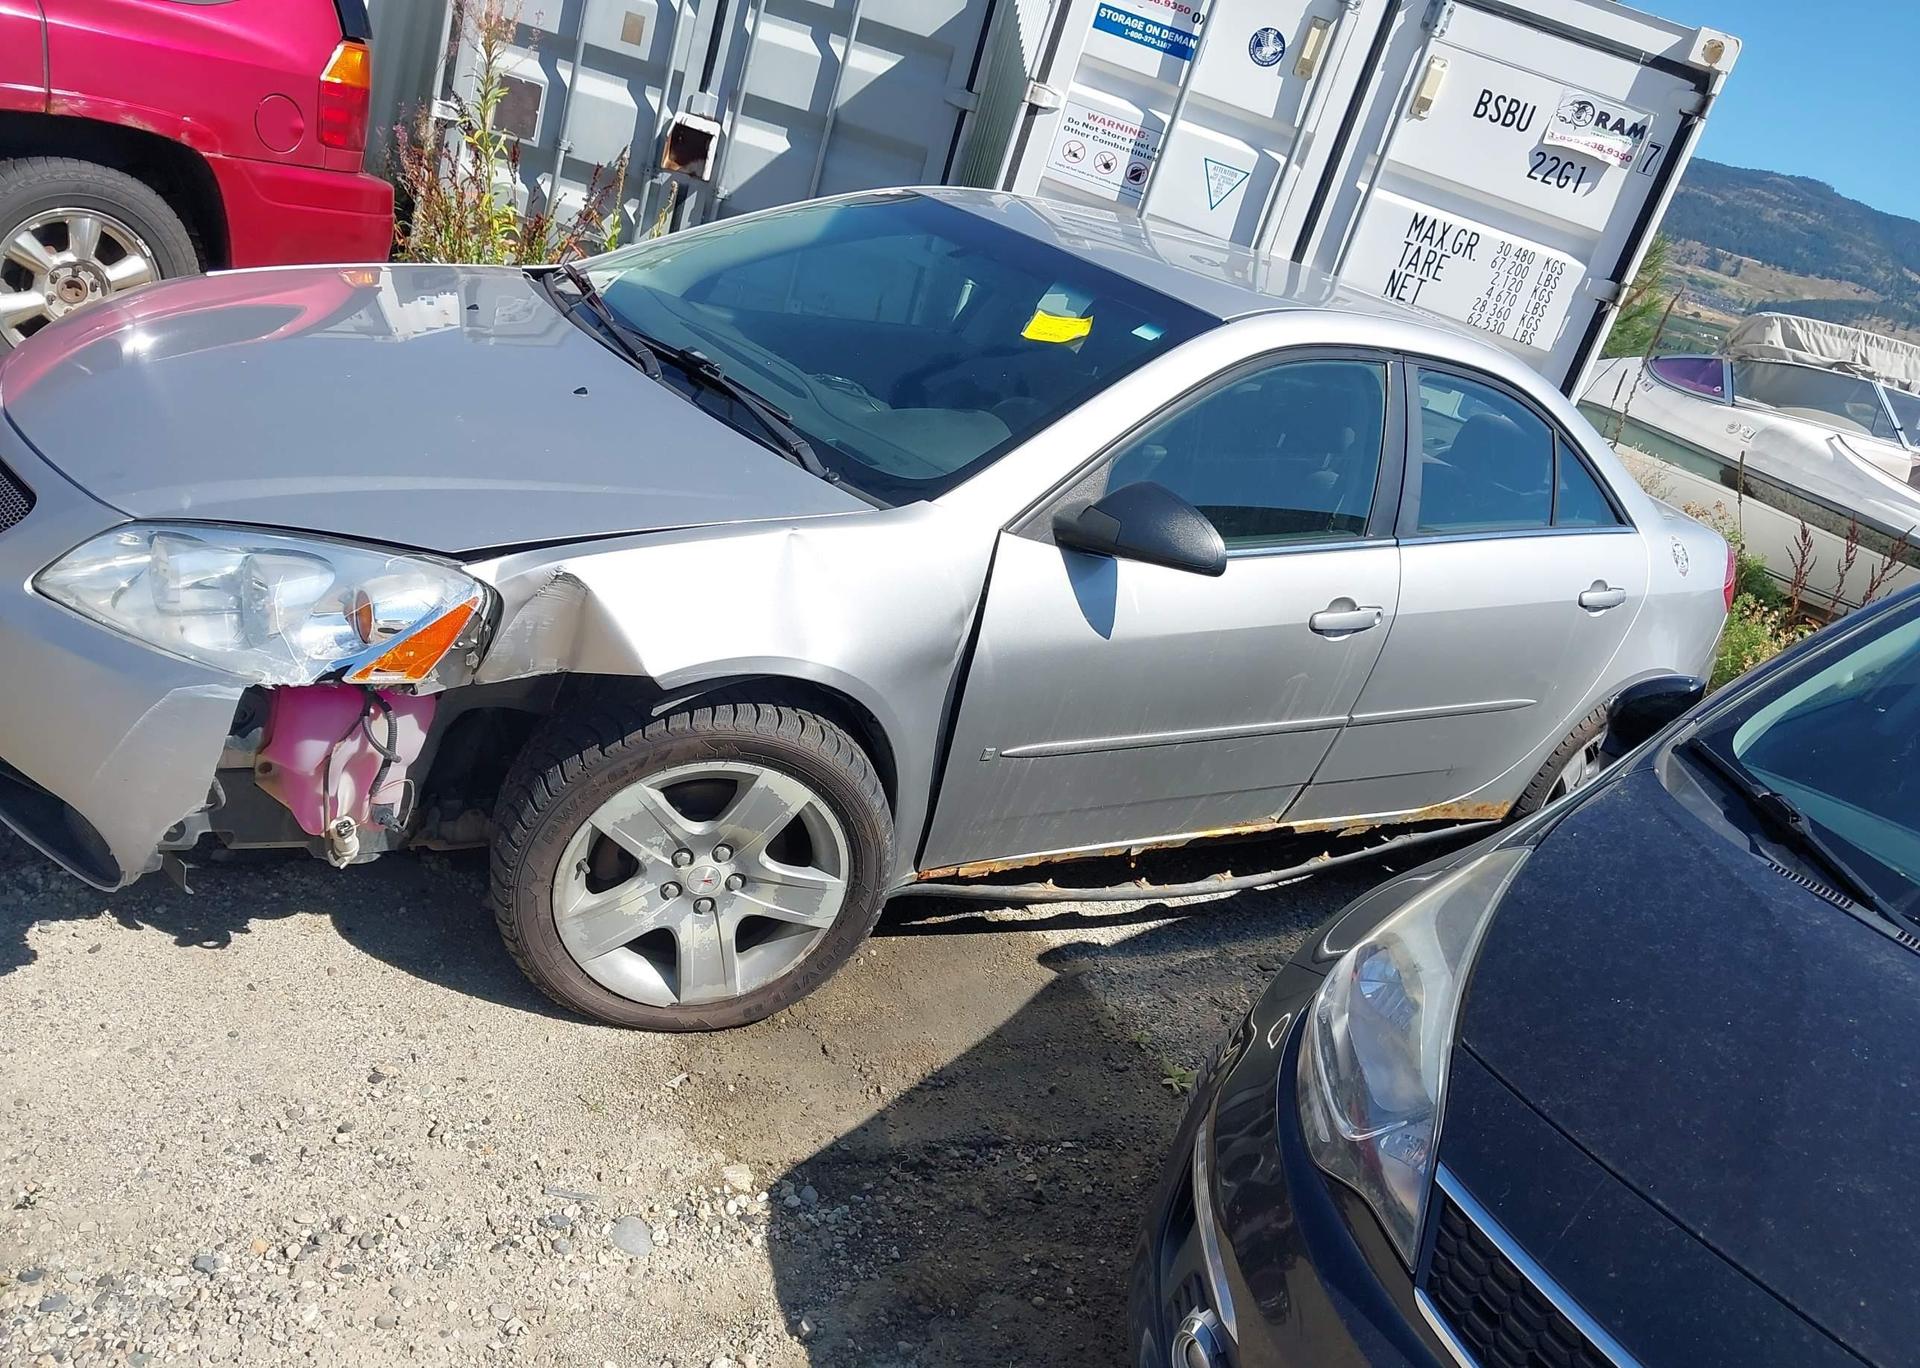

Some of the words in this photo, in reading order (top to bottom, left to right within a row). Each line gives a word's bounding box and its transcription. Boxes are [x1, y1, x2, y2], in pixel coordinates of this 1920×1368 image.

[1099, 8, 1145, 31] STORAGE
[1145, 24, 1161, 36] ON
[1161, 30, 1197, 49] DEMAN
[1473, 89, 1537, 132] BSBU
[1063, 125, 1090, 138] Other
[1067, 117, 1080, 126] Do
[1081, 122, 1099, 133] Not
[1100, 128, 1127, 143] Store
[1129, 138, 1150, 151] Fuel
[1087, 113, 1150, 140] WARNING:
[1594, 111, 1647, 140] RAM
[1526, 152, 1587, 193] 22G1
[1642, 144, 1662, 173] 7
[1399, 241, 1450, 282] TARE
[1543, 257, 1566, 275] KGS
[1384, 269, 1427, 304] NET
[1530, 285, 1553, 304] KGS
[1537, 271, 1560, 290] LBS
[1525, 299, 1547, 317] LBS
[1512, 327, 1535, 345] LBS
[1518, 313, 1541, 332] KGS
